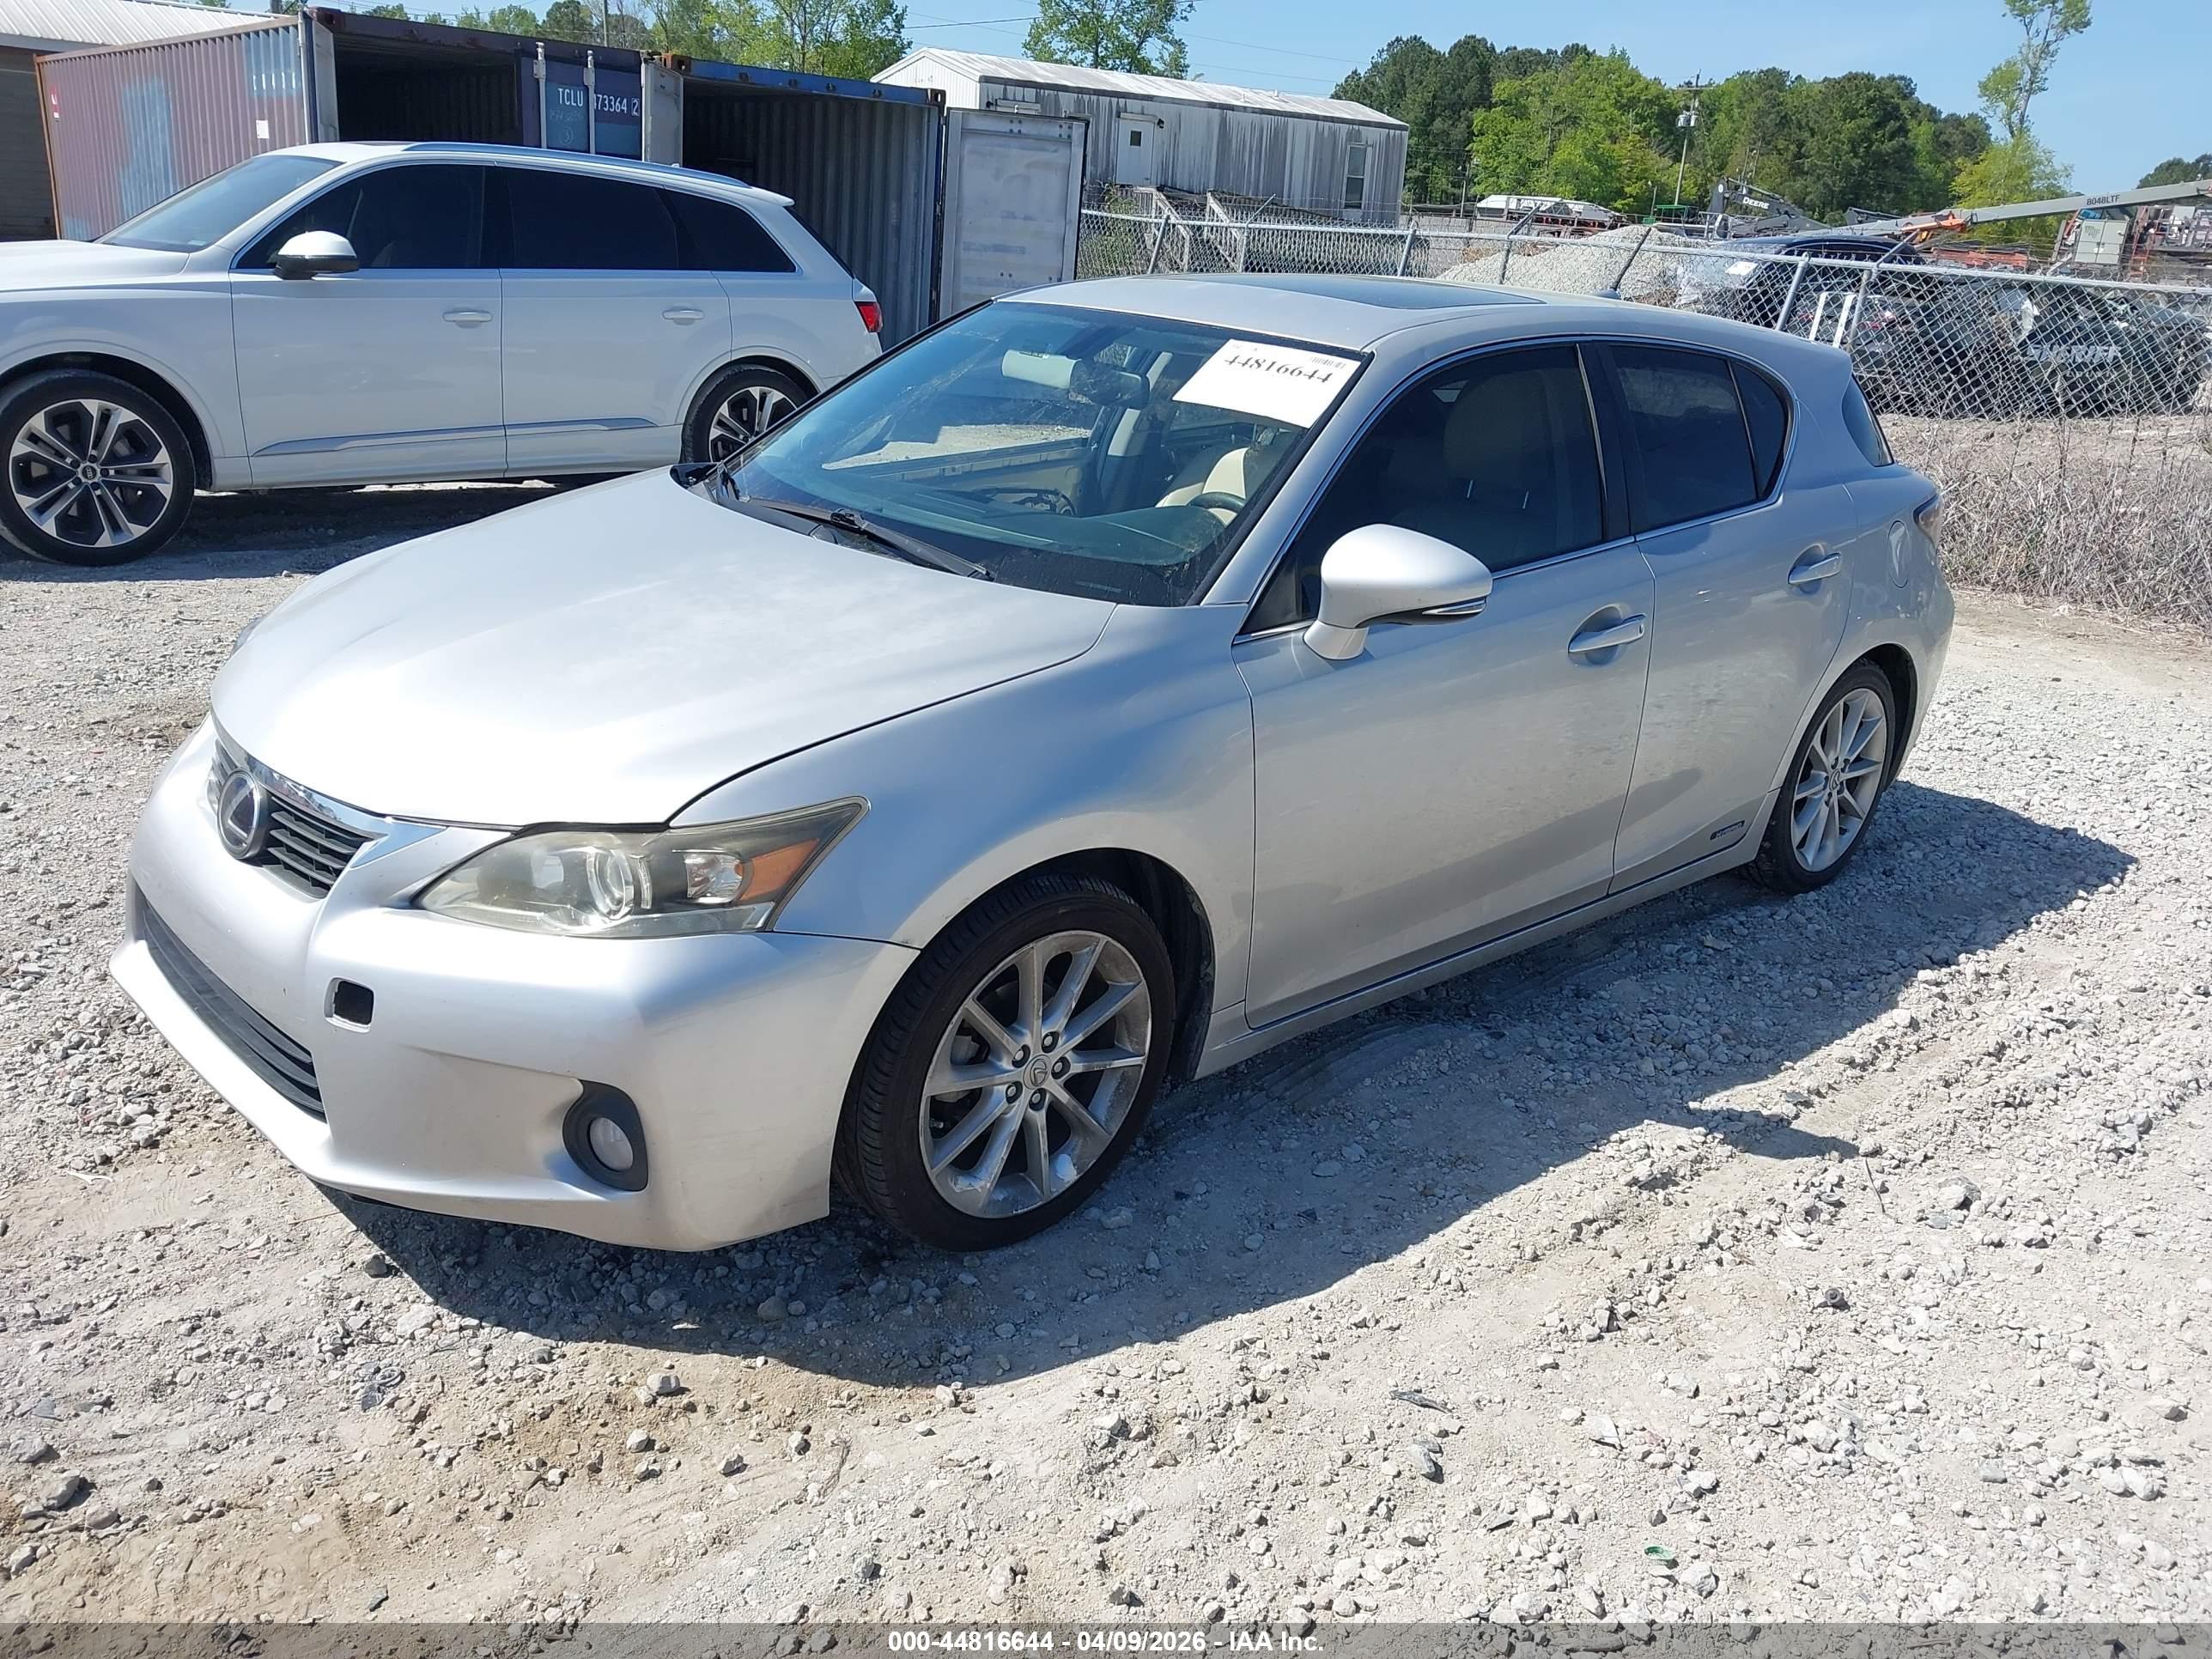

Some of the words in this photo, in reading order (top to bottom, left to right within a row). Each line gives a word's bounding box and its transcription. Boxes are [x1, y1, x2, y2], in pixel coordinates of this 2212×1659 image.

[557, 88, 583, 106] TCLU
[1742, 196, 1770, 209] DEERE
[2087, 194, 2120, 206] 8048LTF
[1224, 355, 1333, 382] 44816644
